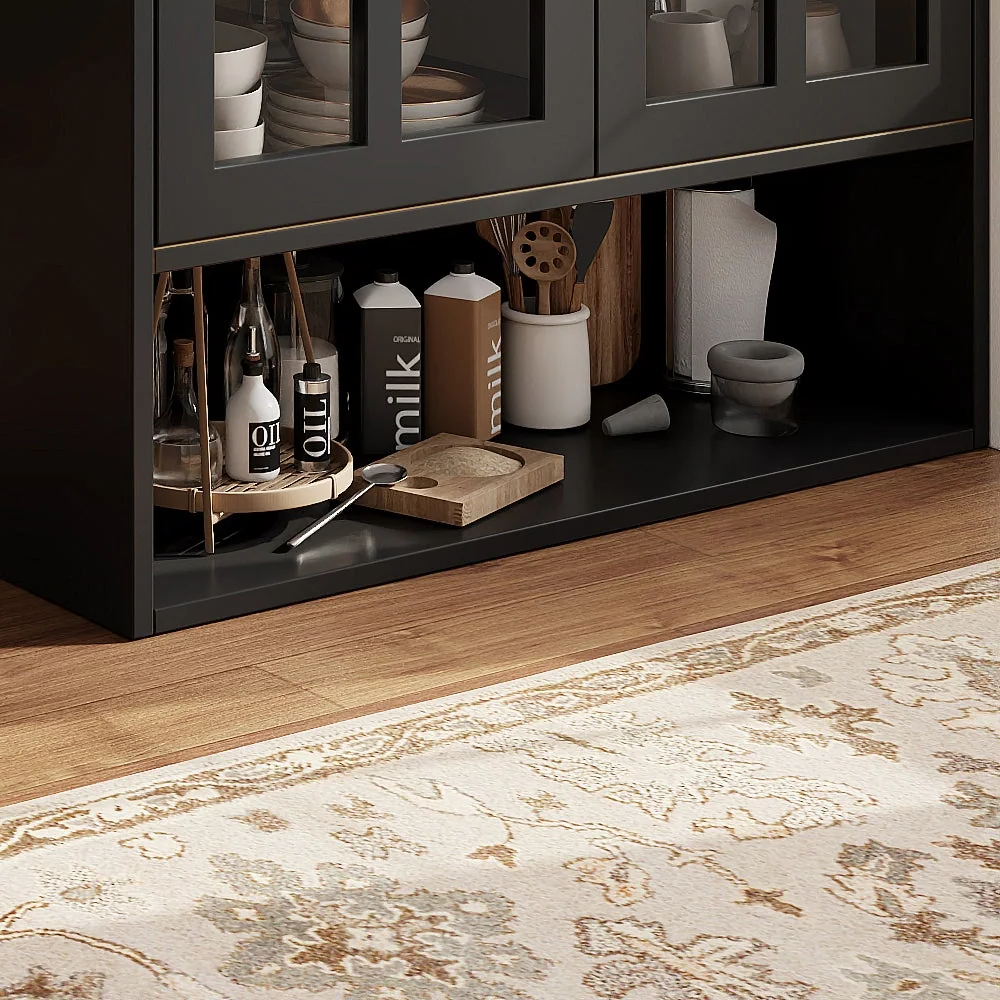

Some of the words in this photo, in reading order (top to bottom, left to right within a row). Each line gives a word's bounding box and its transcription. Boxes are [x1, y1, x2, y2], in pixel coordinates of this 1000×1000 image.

[392, 335, 420, 343] ORIGINAL
[385, 352, 420, 451] milk
[486, 335, 501, 435] milk
[303, 398, 327, 458] OIL
